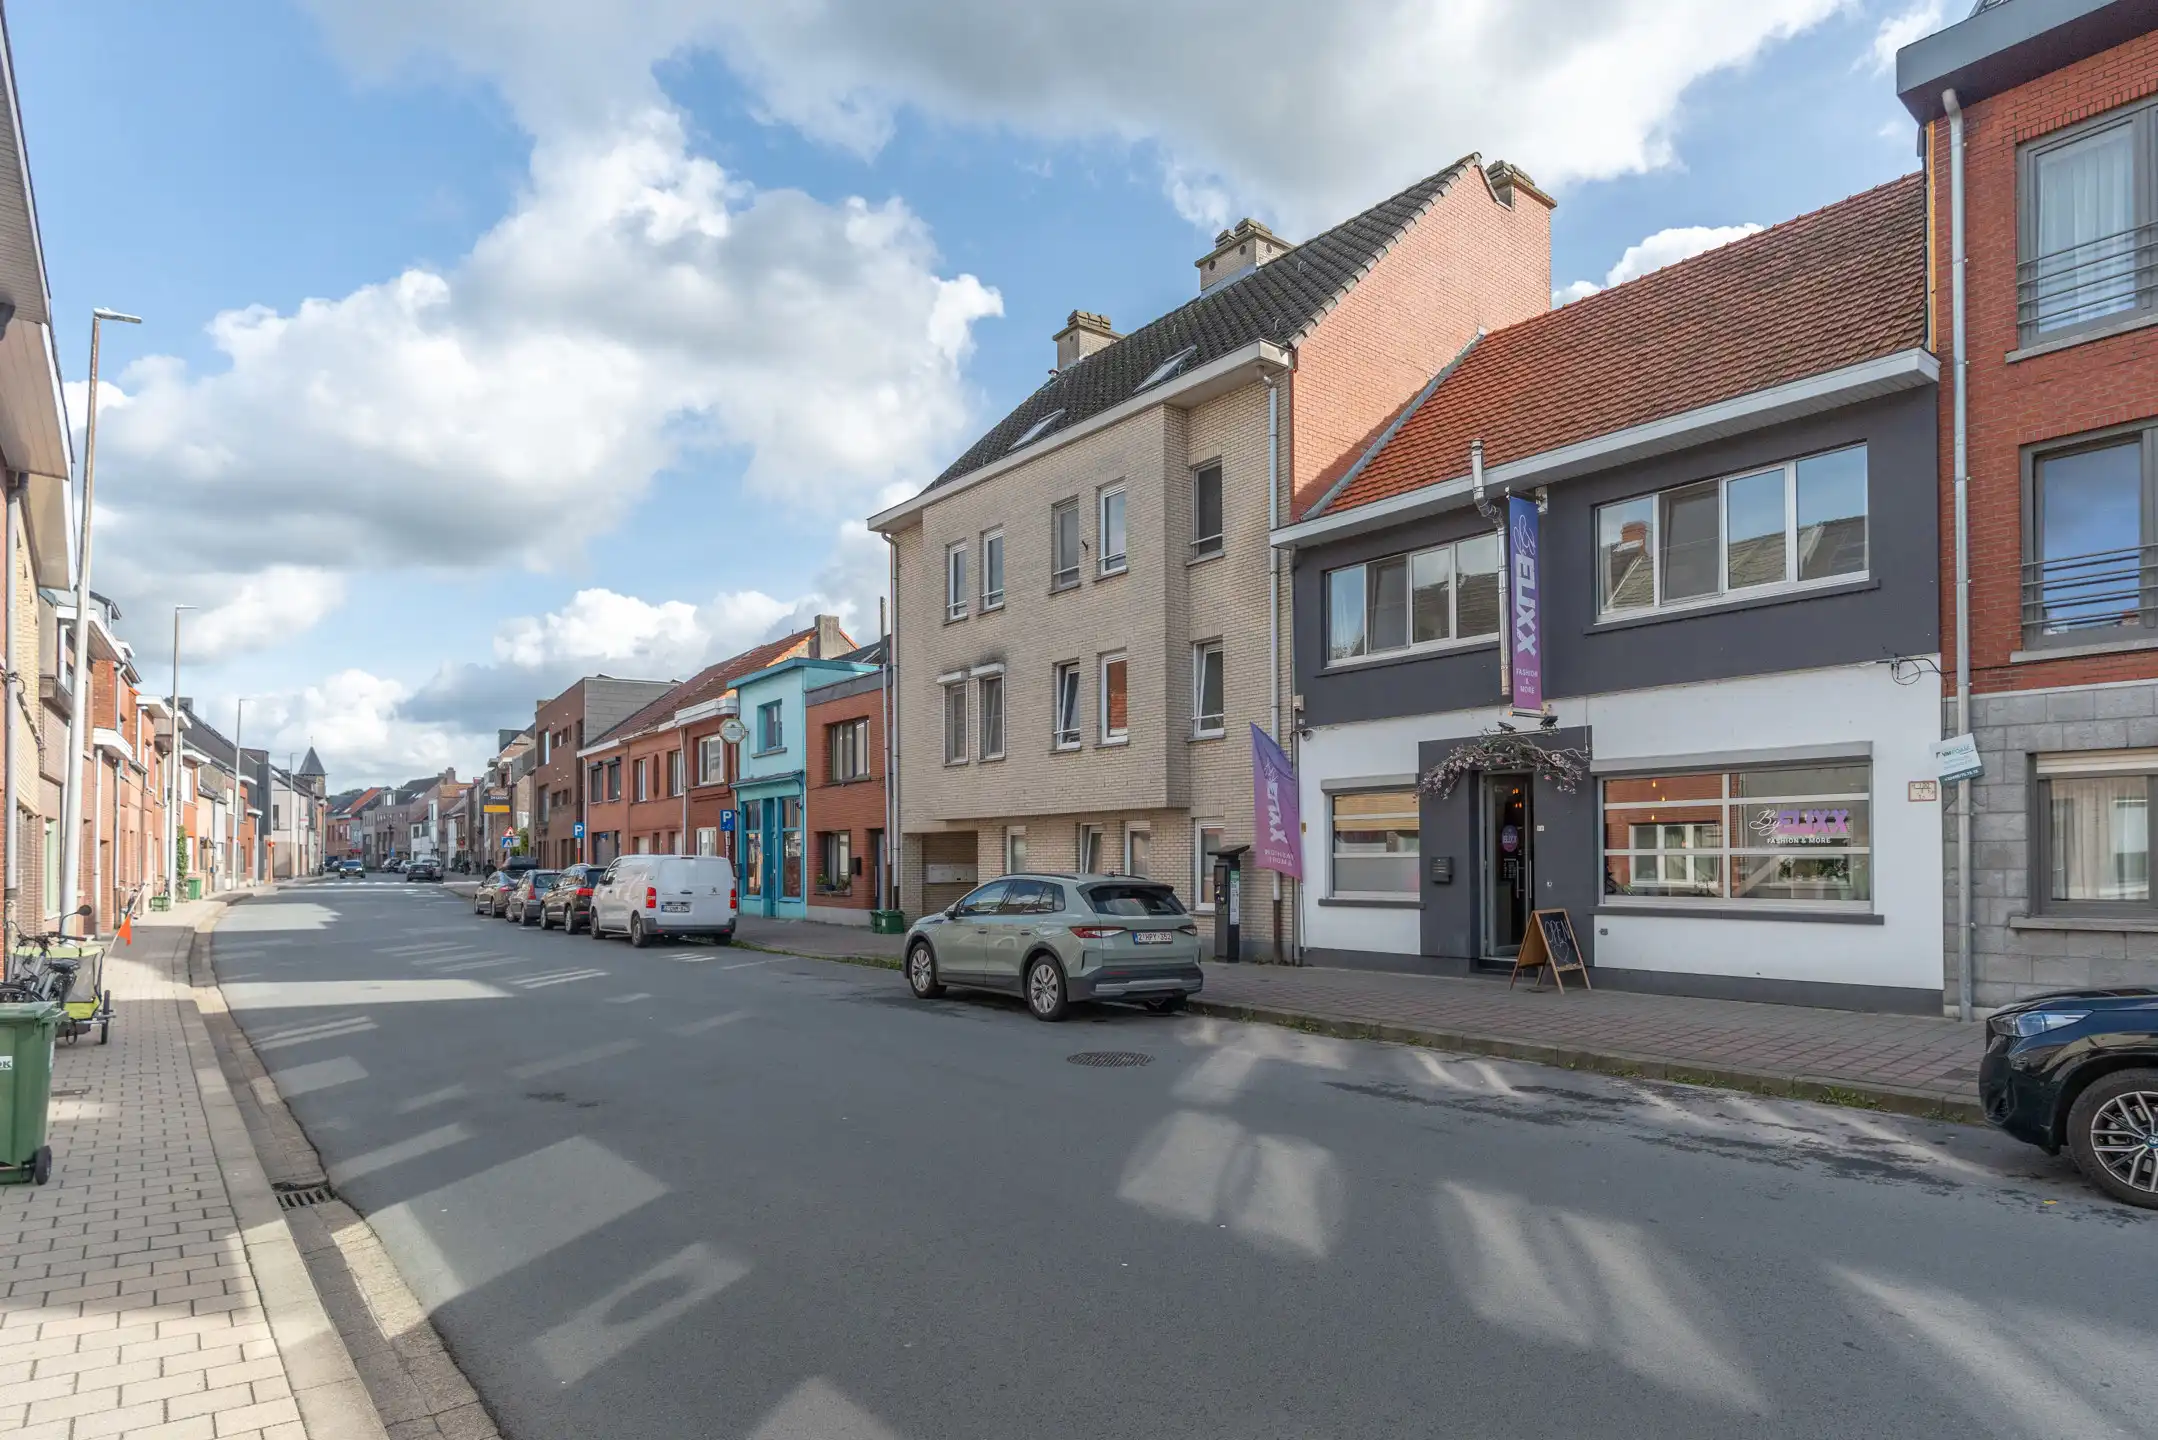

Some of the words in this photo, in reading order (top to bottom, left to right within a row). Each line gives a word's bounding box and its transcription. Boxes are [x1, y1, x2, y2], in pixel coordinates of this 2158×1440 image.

[1515, 668, 1538, 677] FASHION
[1520, 686, 1535, 694] MORE
[723, 811, 732, 823] P
[1749, 809, 1780, 836] By
[574, 824, 583, 836] P
[1545, 920, 1571, 944] OPEN
